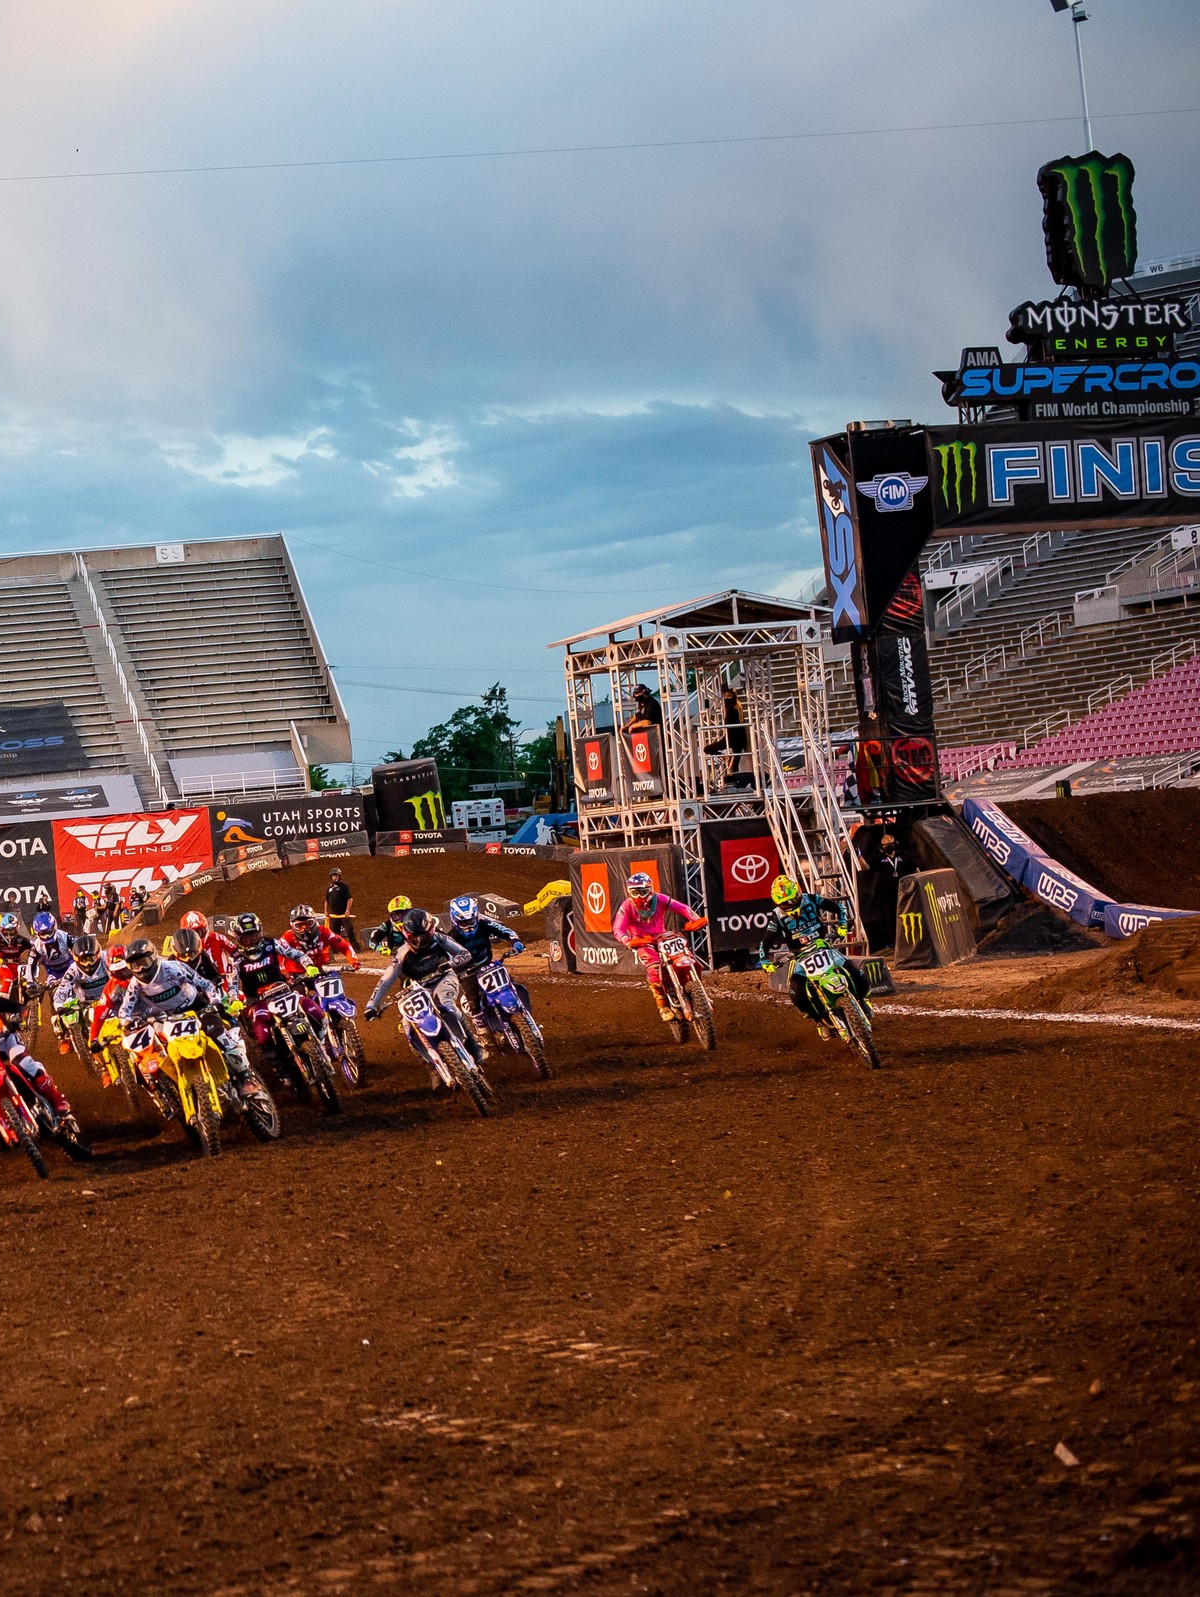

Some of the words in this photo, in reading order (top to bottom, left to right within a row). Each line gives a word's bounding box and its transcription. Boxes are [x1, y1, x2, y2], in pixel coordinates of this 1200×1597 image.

[1150, 264, 1164, 273] W6
[1055, 336, 1167, 350] ENERGY
[966, 351, 1000, 367] AMA
[960, 362, 1200, 397] SUPERCRO
[1035, 403, 1059, 417] FIM
[1062, 402, 1099, 416] World
[1101, 399, 1191, 417] Championship
[986, 434, 1200, 507] FINIS
[882, 485, 905, 500] FIM
[1190, 529, 1198, 544] 8
[950, 571, 959, 585] 7
[588, 787, 608, 799] TOYOTA
[632, 780, 655, 792] TOYOTA
[262, 811, 301, 824] UTAH
[306, 806, 361, 820] SPORTS
[264, 821, 363, 837] COMMISSION
[414, 832, 443, 840] TOYOTA
[319, 837, 348, 848] TOYOTA
[972, 816, 1012, 866] WPS
[94, 846, 175, 858] RACING
[503, 846, 538, 856] TOYOTA
[192, 874, 214, 888] TOYOTA
[1037, 872, 1079, 913] WPS
[717, 911, 773, 933] TOYO
[663, 938, 687, 955] 976
[582, 947, 619, 965] TOYOTA
[804, 950, 832, 975] 501
[482, 967, 508, 991] 211
[319, 980, 340, 998] 11
[274, 993, 298, 1017] 37
[170, 1021, 198, 1038] 44
